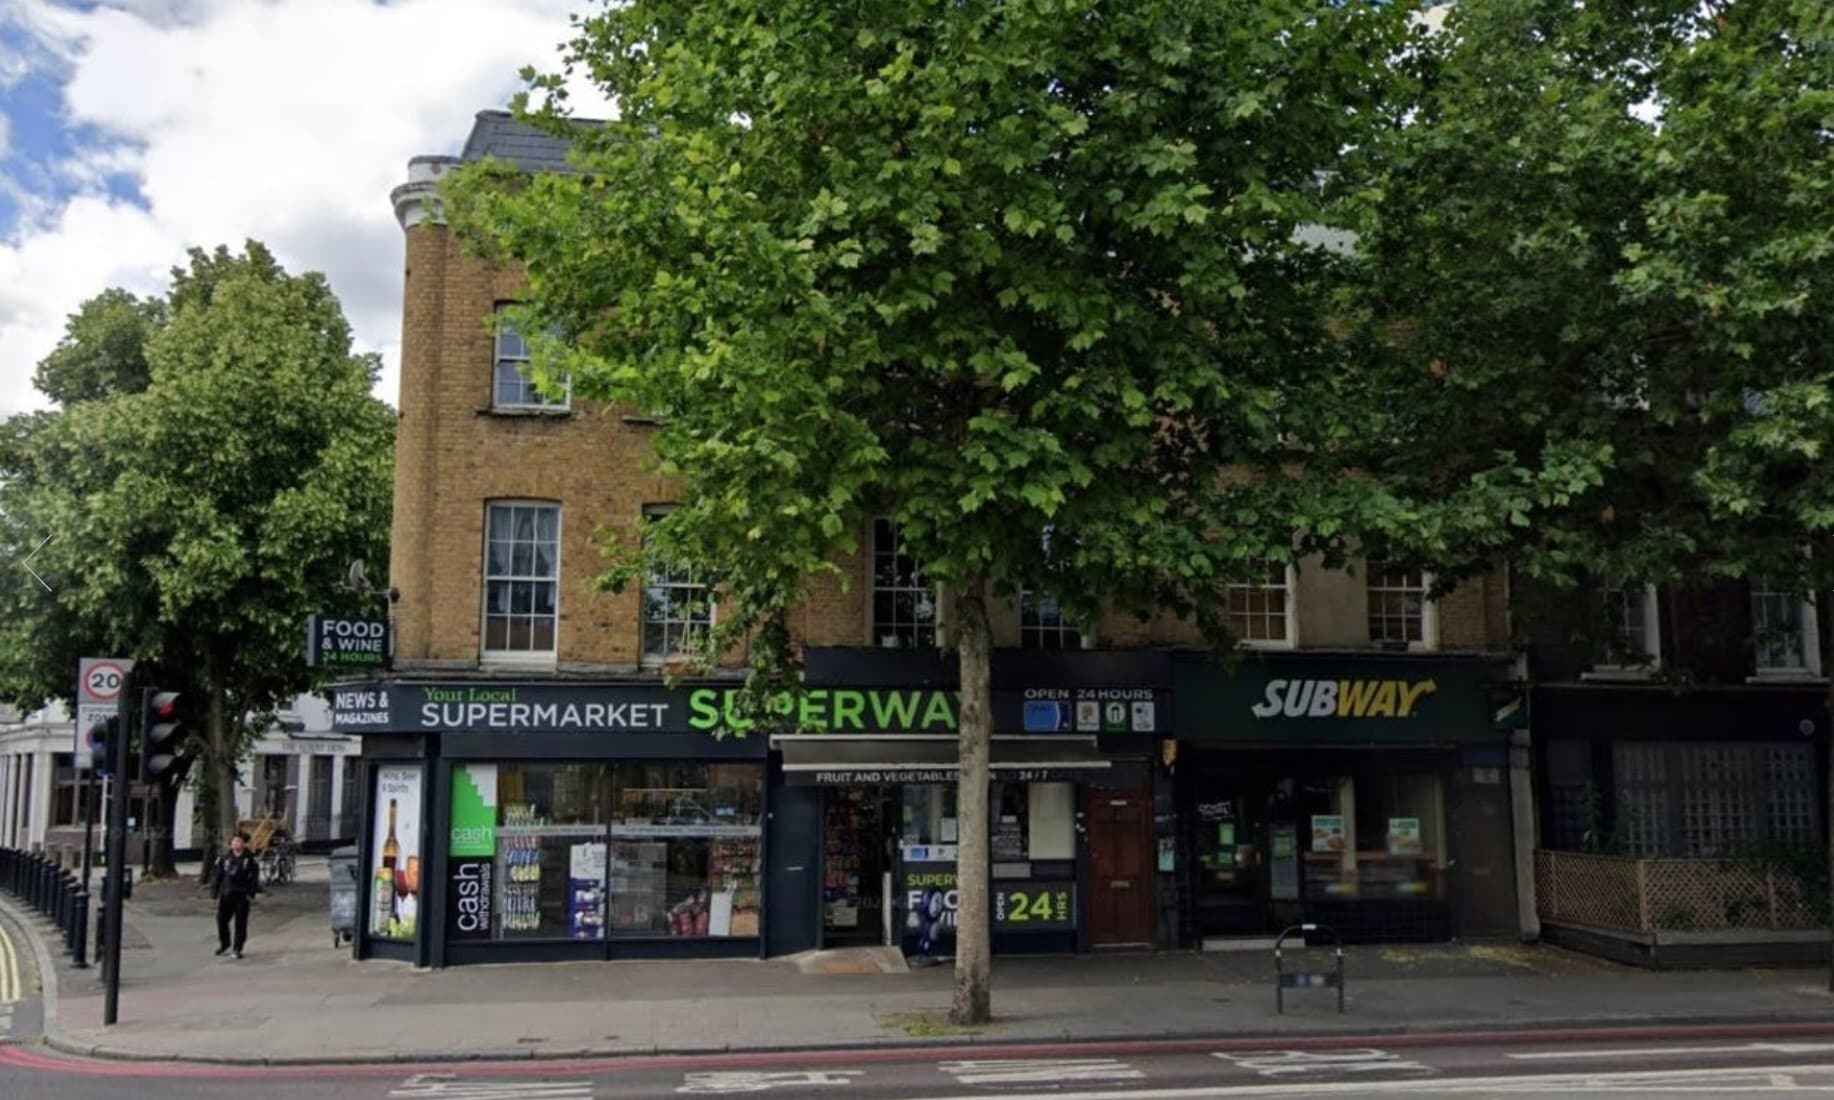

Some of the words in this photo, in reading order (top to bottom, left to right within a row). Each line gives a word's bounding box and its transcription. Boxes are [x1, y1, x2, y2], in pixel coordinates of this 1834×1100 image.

[322, 620, 384, 638] FOOD
[322, 637, 332, 650] &
[338, 638, 382, 652] WINE
[341, 652, 382, 662] HOURS
[92, 673, 120, 689] 20
[336, 692, 376, 709] NEWS
[379, 691, 389, 709] &
[424, 688, 462, 702] Your
[469, 687, 517, 702] Local
[1024, 689, 1070, 699] OPEN
[1252, 679, 1437, 718] SUBWAY
[335, 712, 389, 724] MAGAZINES
[421, 703, 669, 727] SUPERMARKET
[816, 772, 852, 782] FRUIT
[855, 772, 880, 782] AND
[451, 826, 492, 841] cash
[453, 863, 479, 931] cash
[479, 864, 491, 930] withdrawals
[996, 892, 1005, 920] OPEN
[1008, 891, 1053, 921] 24
[1056, 891, 1067, 920] HRS
